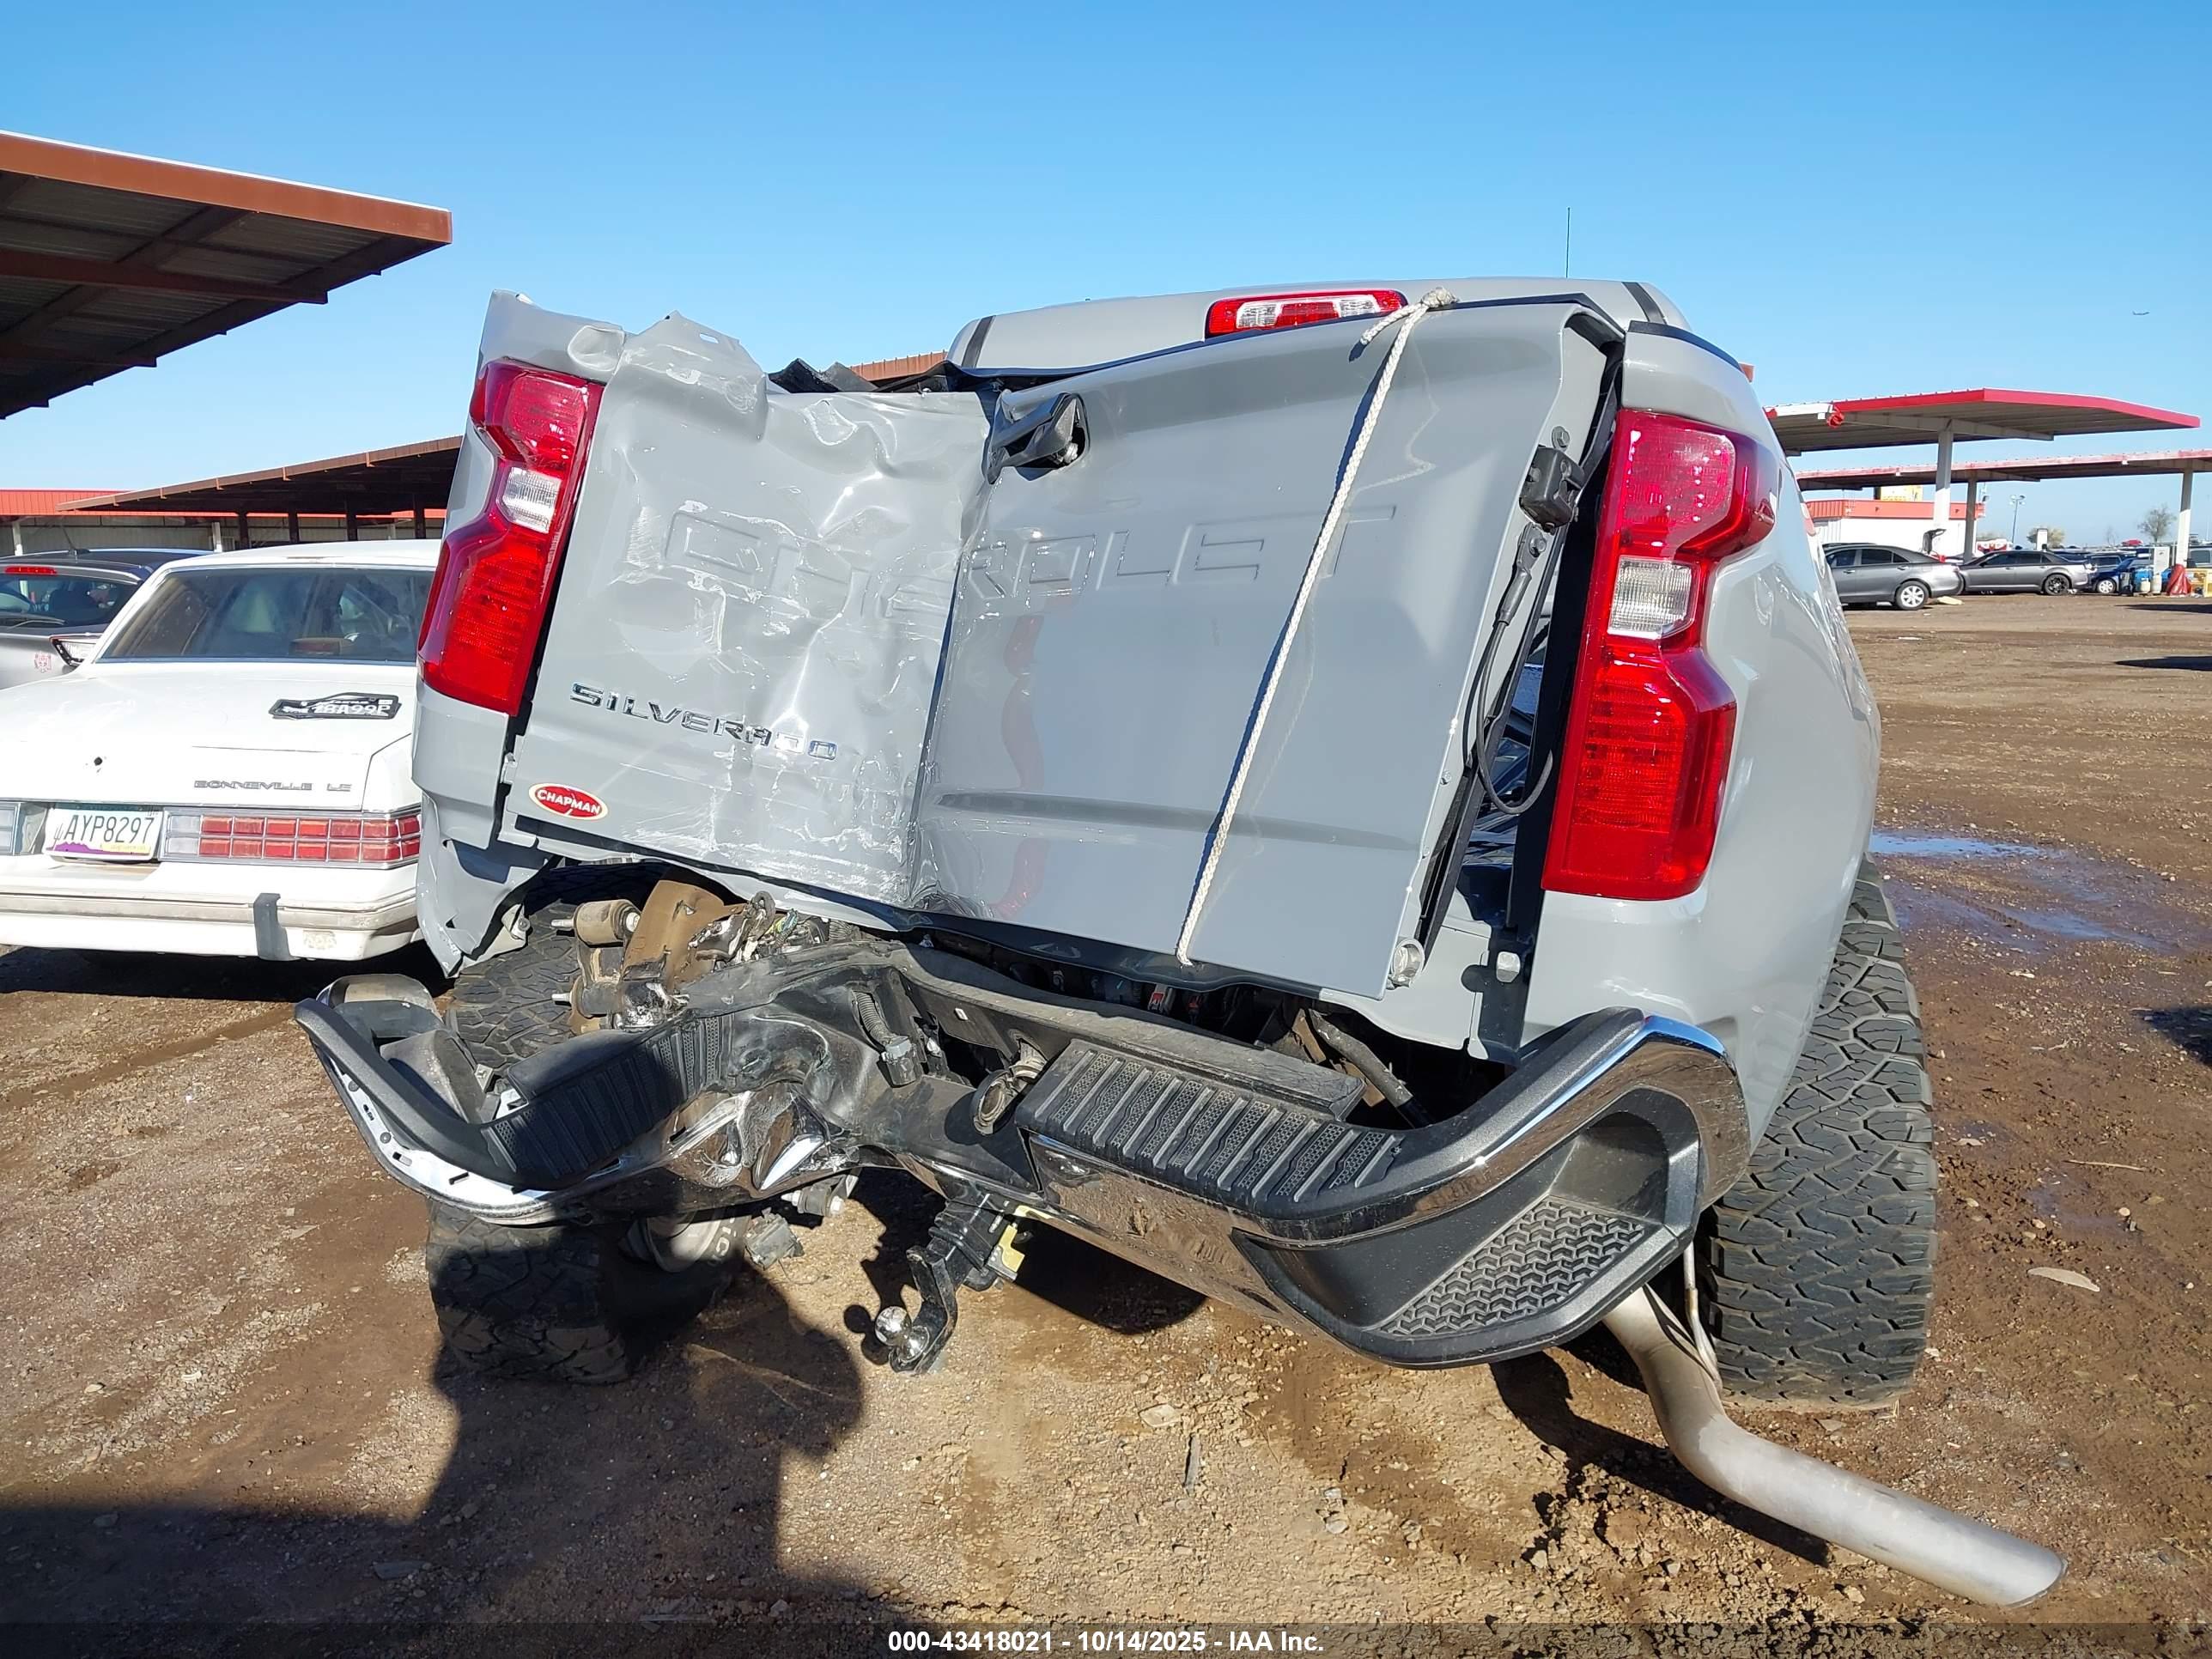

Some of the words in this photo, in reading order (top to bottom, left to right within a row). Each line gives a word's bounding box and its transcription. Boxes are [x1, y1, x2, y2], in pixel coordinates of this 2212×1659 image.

[569, 682, 838, 761] SILVERADO
[537, 789, 601, 814] CHAPMAN
[63, 814, 155, 843] AYP8297
